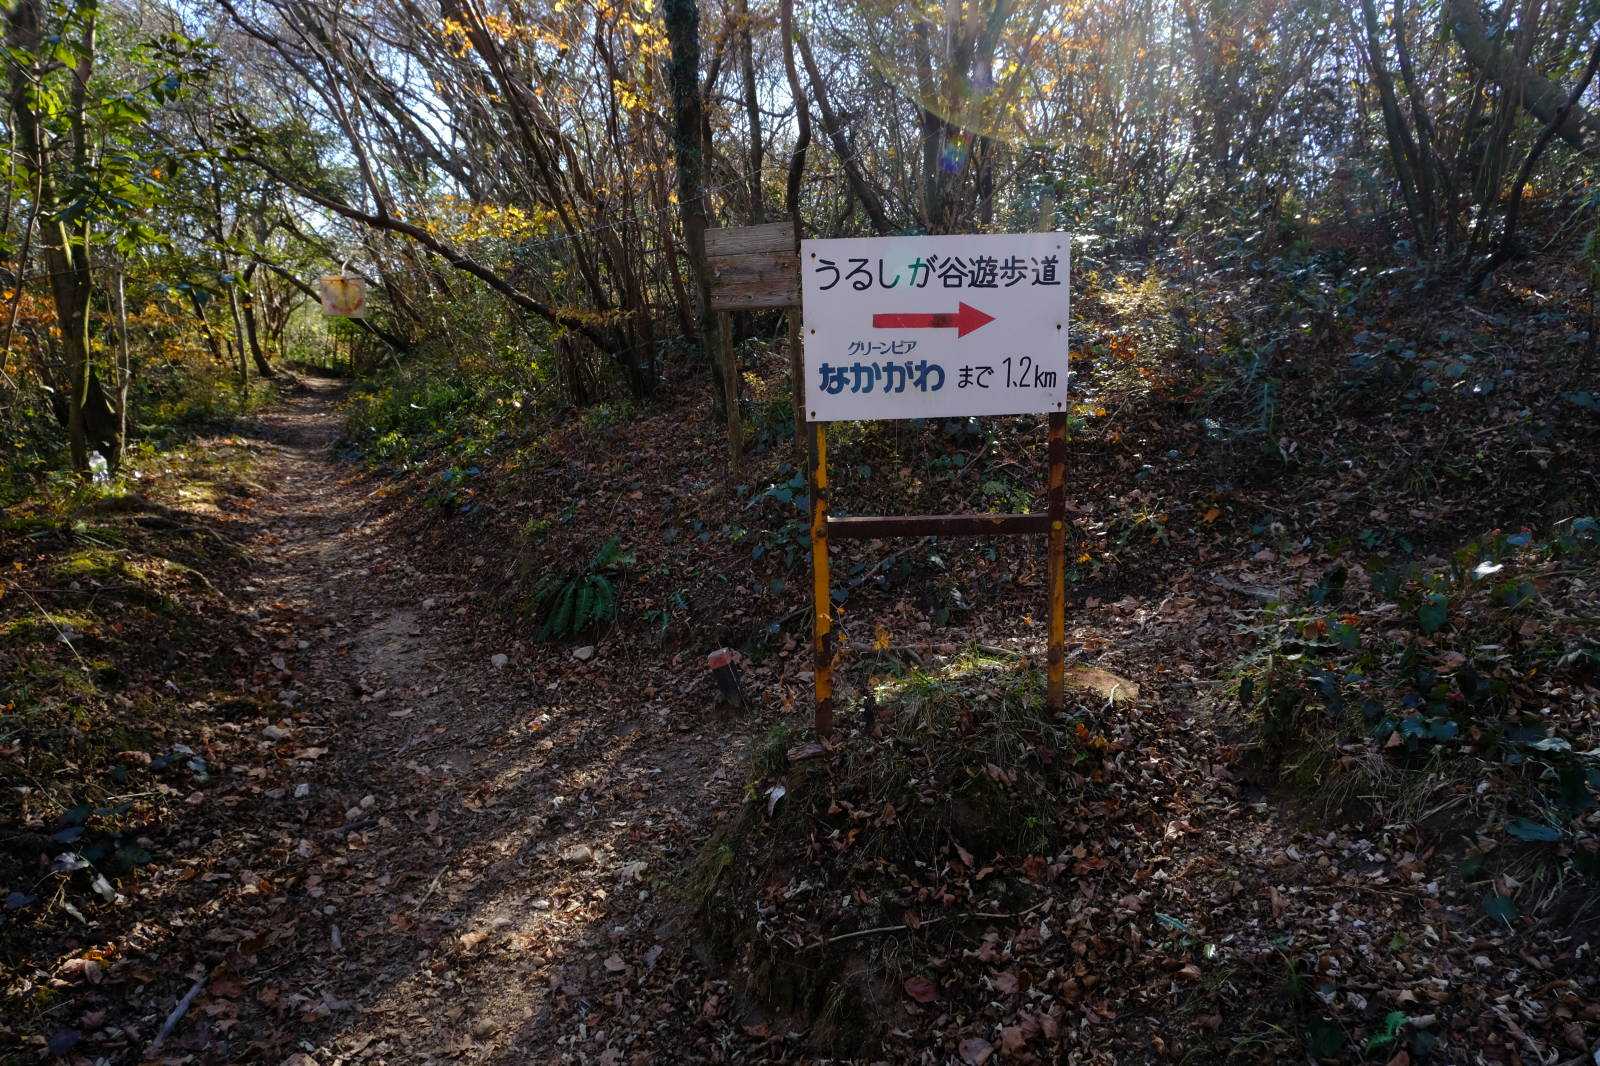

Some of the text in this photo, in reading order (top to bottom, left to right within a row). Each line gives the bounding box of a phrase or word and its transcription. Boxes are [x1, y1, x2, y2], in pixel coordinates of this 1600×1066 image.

[815, 254, 1061, 291] うるしが谷遊歩道
[848, 340, 918, 356] グリーンピア
[819, 359, 946, 395] なかがわ
[957, 364, 995, 389] まで
